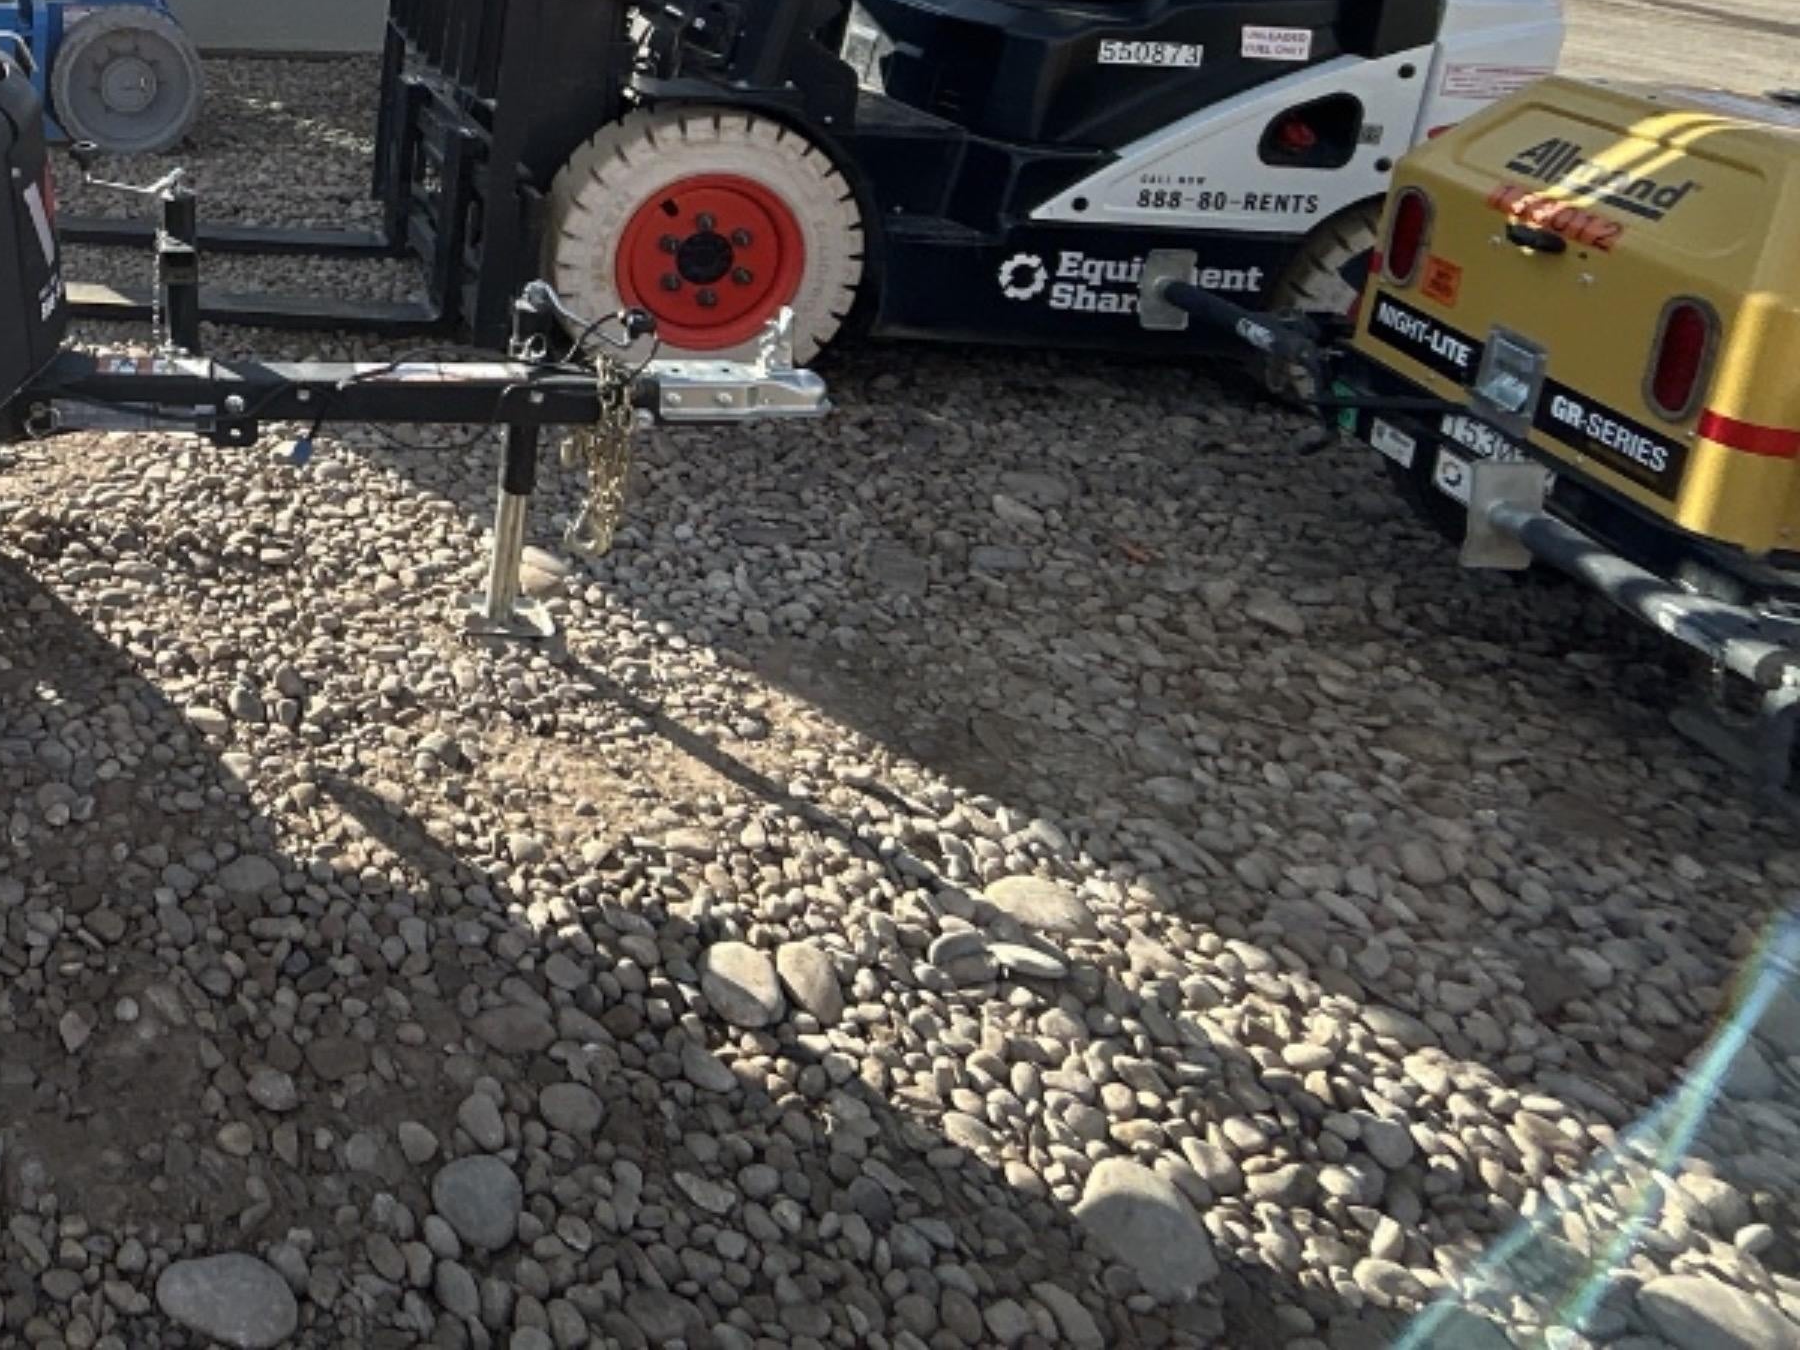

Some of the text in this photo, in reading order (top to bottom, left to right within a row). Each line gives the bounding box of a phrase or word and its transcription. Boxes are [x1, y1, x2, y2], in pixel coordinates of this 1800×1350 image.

[1101, 40, 1202, 66] 550873
[1136, 189, 1320, 214] 888-80-RENTS
[1055, 251, 1265, 292] Equient
[1049, 282, 1142, 314] Shar
[1376, 300, 1473, 367] NIGHT-LITE
[1550, 394, 1669, 473] GR-SERIES
